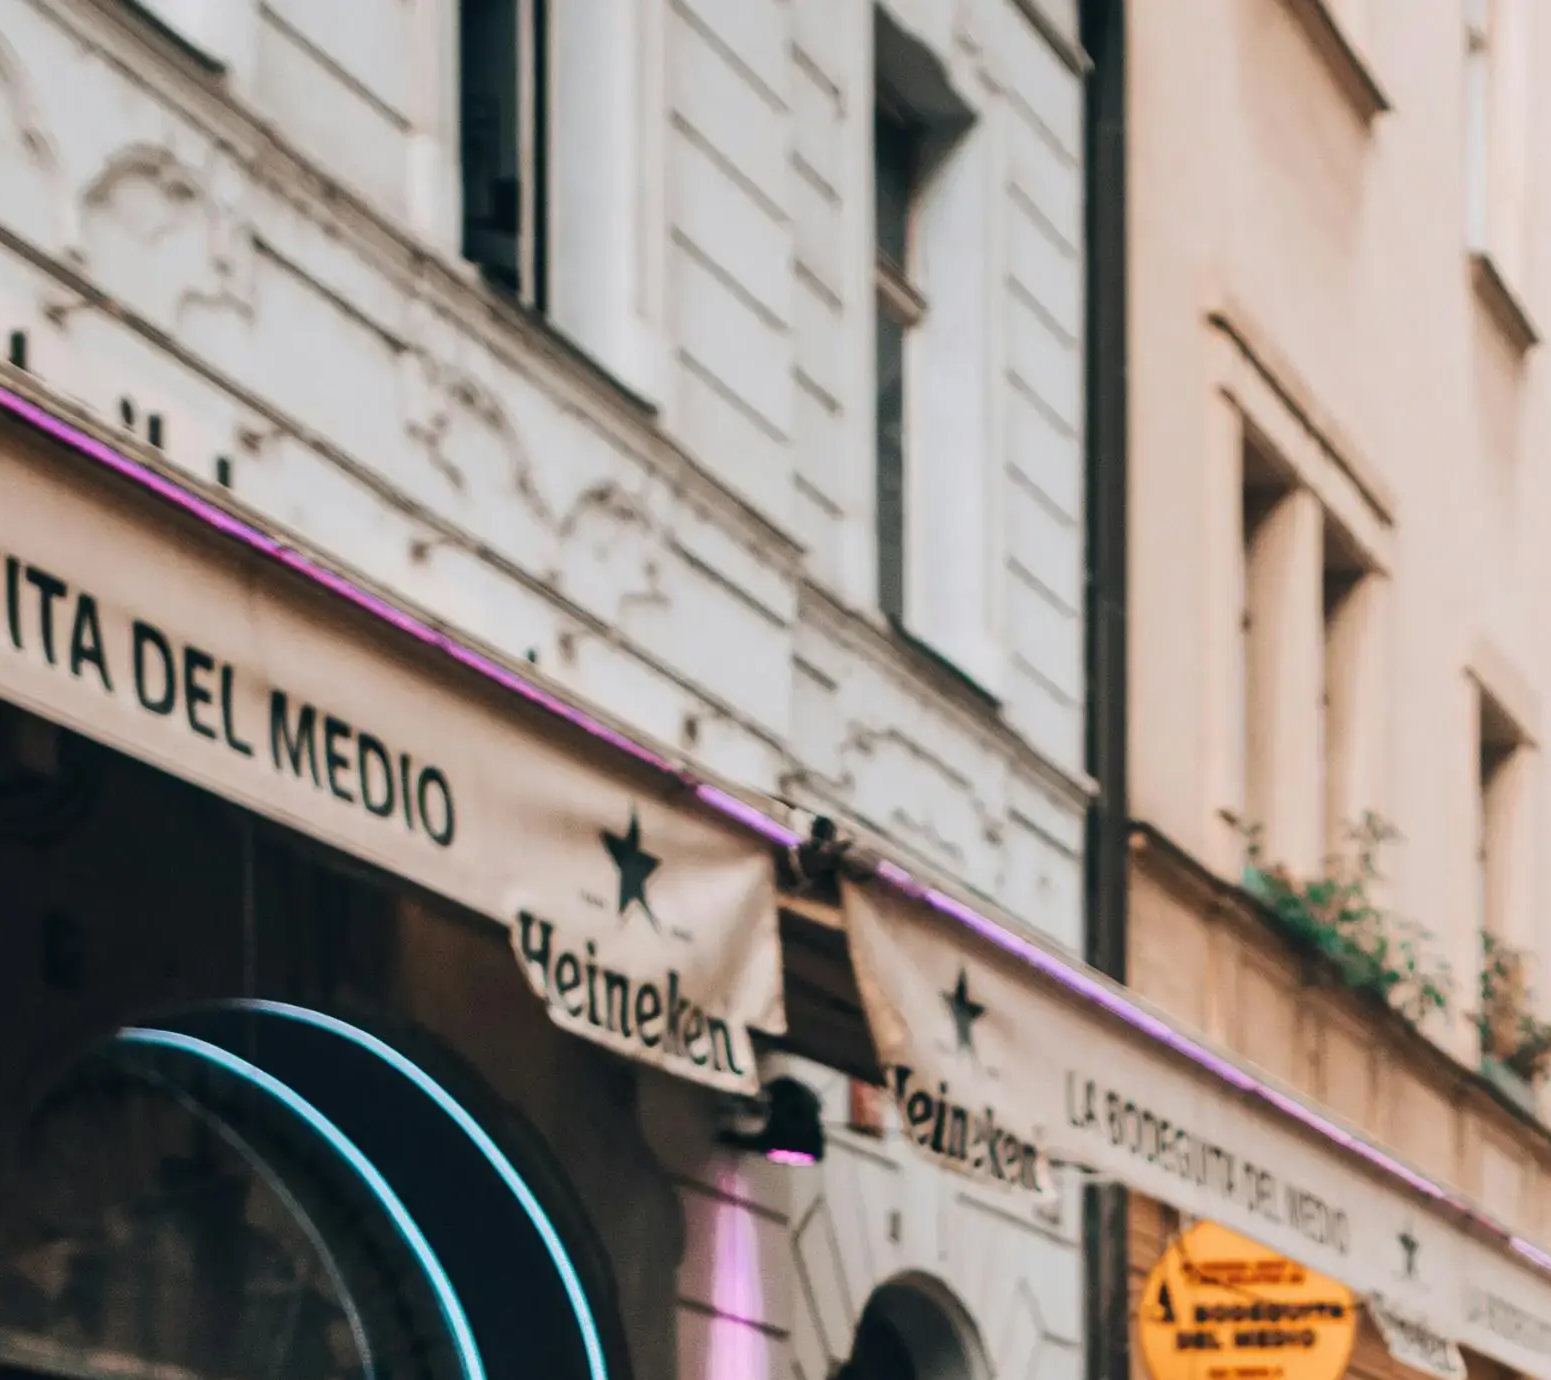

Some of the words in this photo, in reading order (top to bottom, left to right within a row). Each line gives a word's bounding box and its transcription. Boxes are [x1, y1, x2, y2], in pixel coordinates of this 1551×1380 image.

[132, 618, 254, 758] DEL
[270, 688, 456, 848] MEDIO
[518, 907, 744, 1076] Heineken
